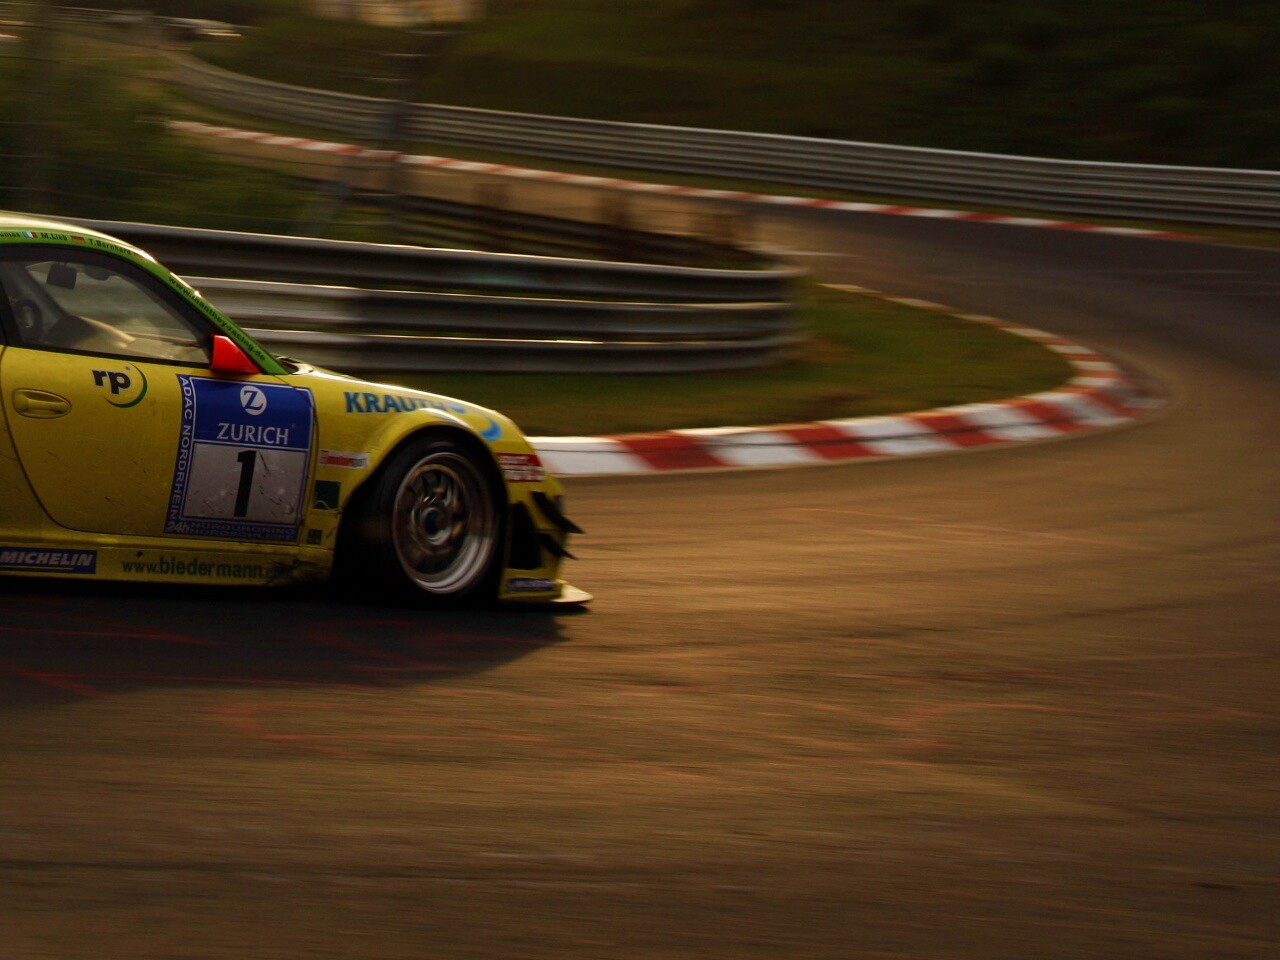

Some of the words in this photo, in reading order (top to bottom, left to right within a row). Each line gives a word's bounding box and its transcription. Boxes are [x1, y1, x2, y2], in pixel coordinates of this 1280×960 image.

[91, 369, 131, 395] rp
[179, 376, 193, 420] ADAC
[216, 422, 290, 446] ZURICH
[168, 425, 193, 520] NORDRHEIN
[233, 450, 257, 518] 1
[0, 550, 94, 567] MICHELIN
